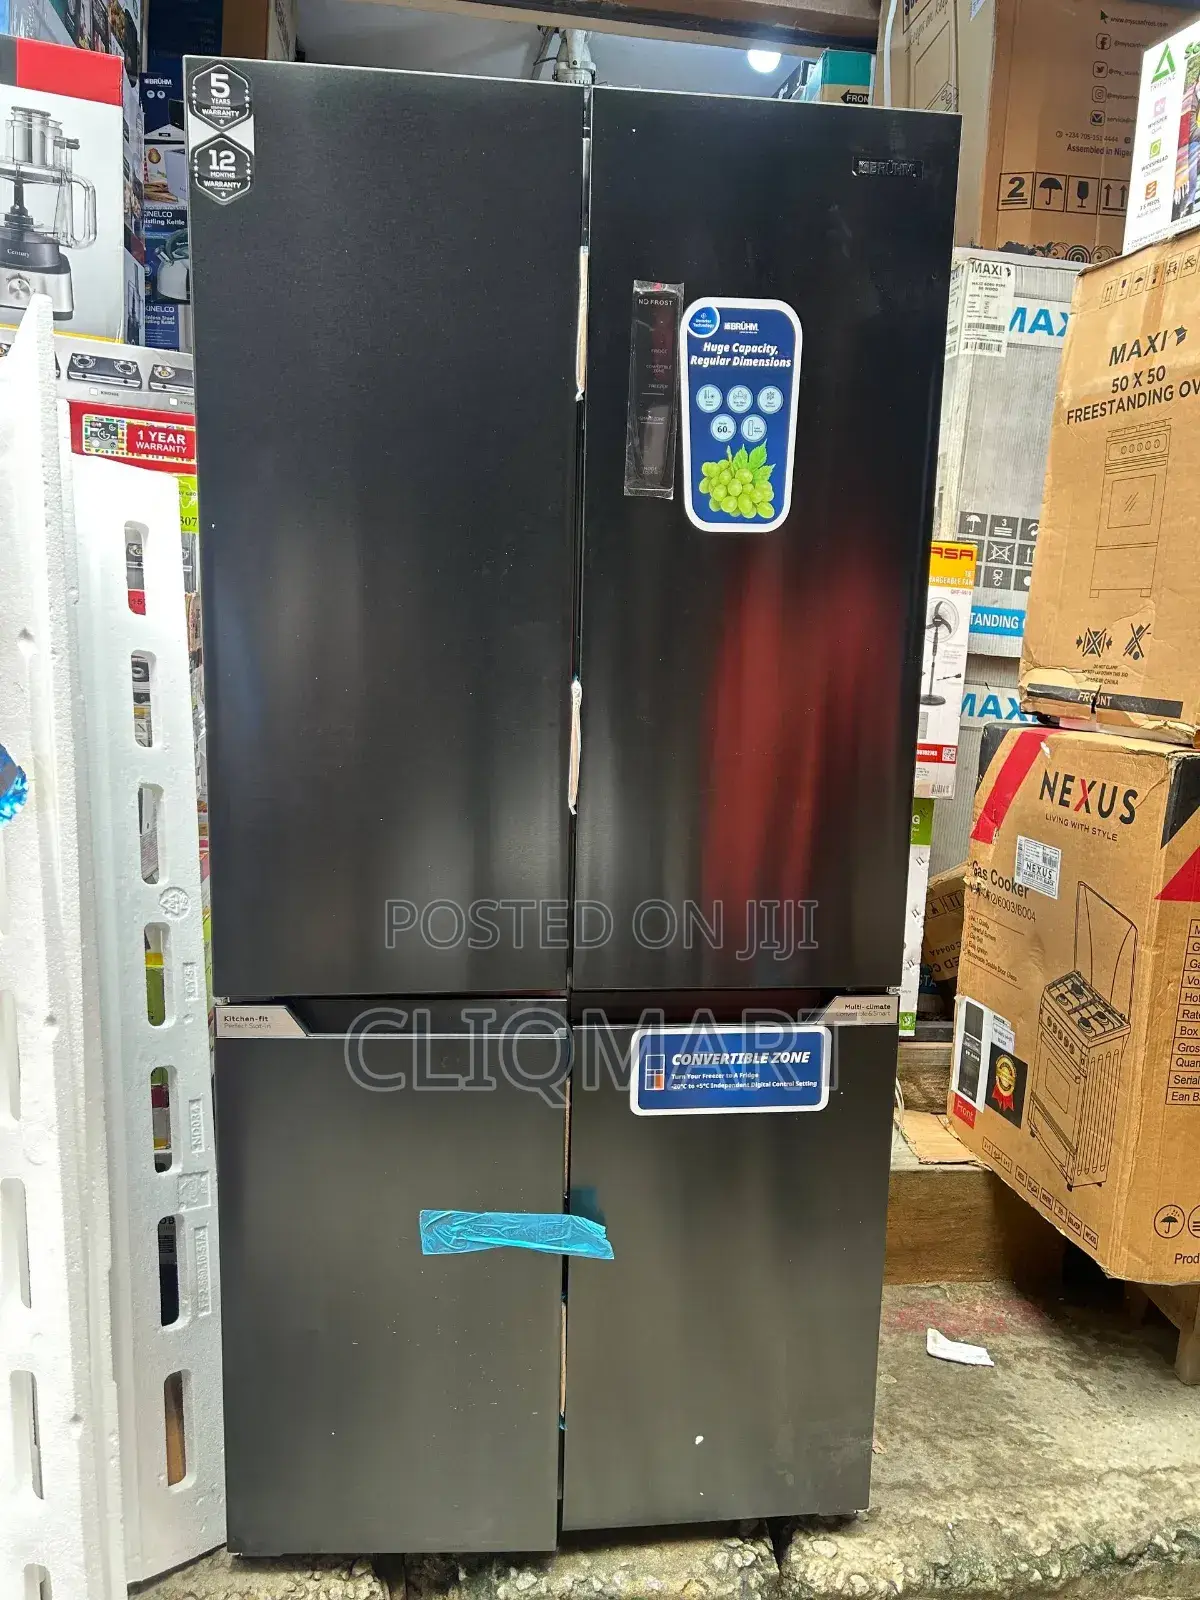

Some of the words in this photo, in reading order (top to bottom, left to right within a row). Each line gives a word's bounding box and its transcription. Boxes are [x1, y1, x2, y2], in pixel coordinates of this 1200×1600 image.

[210, 72, 230, 98] 5
[202, 108, 240, 117] WARRANTY
[1066, 143, 1105, 155] Assembled
[1106, 146, 1114, 155] in
[208, 149, 236, 171] 12
[203, 180, 242, 189] WARRANTY
[1008, 177, 1025, 198] 2
[7, 248, 30, 258] Century
[971, 261, 1003, 276] MAXI
[730, 321, 758, 331] BRÜHM
[703, 342, 730, 354] Huge
[731, 342, 778, 356] Capacity,
[1108, 329, 1168, 367] MAXI
[690, 355, 731, 367] Regular
[732, 356, 791, 367] Dimensions
[1111, 375, 1129, 394] 50
[1133, 371, 1144, 389] X
[1147, 365, 1166, 385] 50
[1066, 384, 1174, 425] FREESTANDING
[138, 430, 144, 440] 1
[148, 431, 186, 445] YEAR
[135, 441, 187, 454] WARRANTY
[1077, 691, 1113, 707] FRONT
[1038, 768, 1139, 825] NEXUS
[1045, 813, 1069, 828] LIVING
[1070, 820, 1090, 834] WITH
[1091, 827, 1118, 843] STYLE
[1026, 861, 1053, 880] NEXUS
[972, 860, 988, 881] Gas
[990, 868, 1030, 899] Cooker
[1179, 1025, 1198, 1036] Box
[671, 1052, 770, 1066] CONVERTIBLE
[770, 1051, 811, 1064] ZONE
[739, 1072, 760, 1080] Fridge
[710, 1082, 750, 1090] Independent
[751, 1081, 771, 1089] Digital
[795, 1080, 817, 1088] Setting
[1171, 1092, 1189, 1102] Ean
[957, 1100, 974, 1121] Front
[1174, 1253, 1200, 1265] Prod
